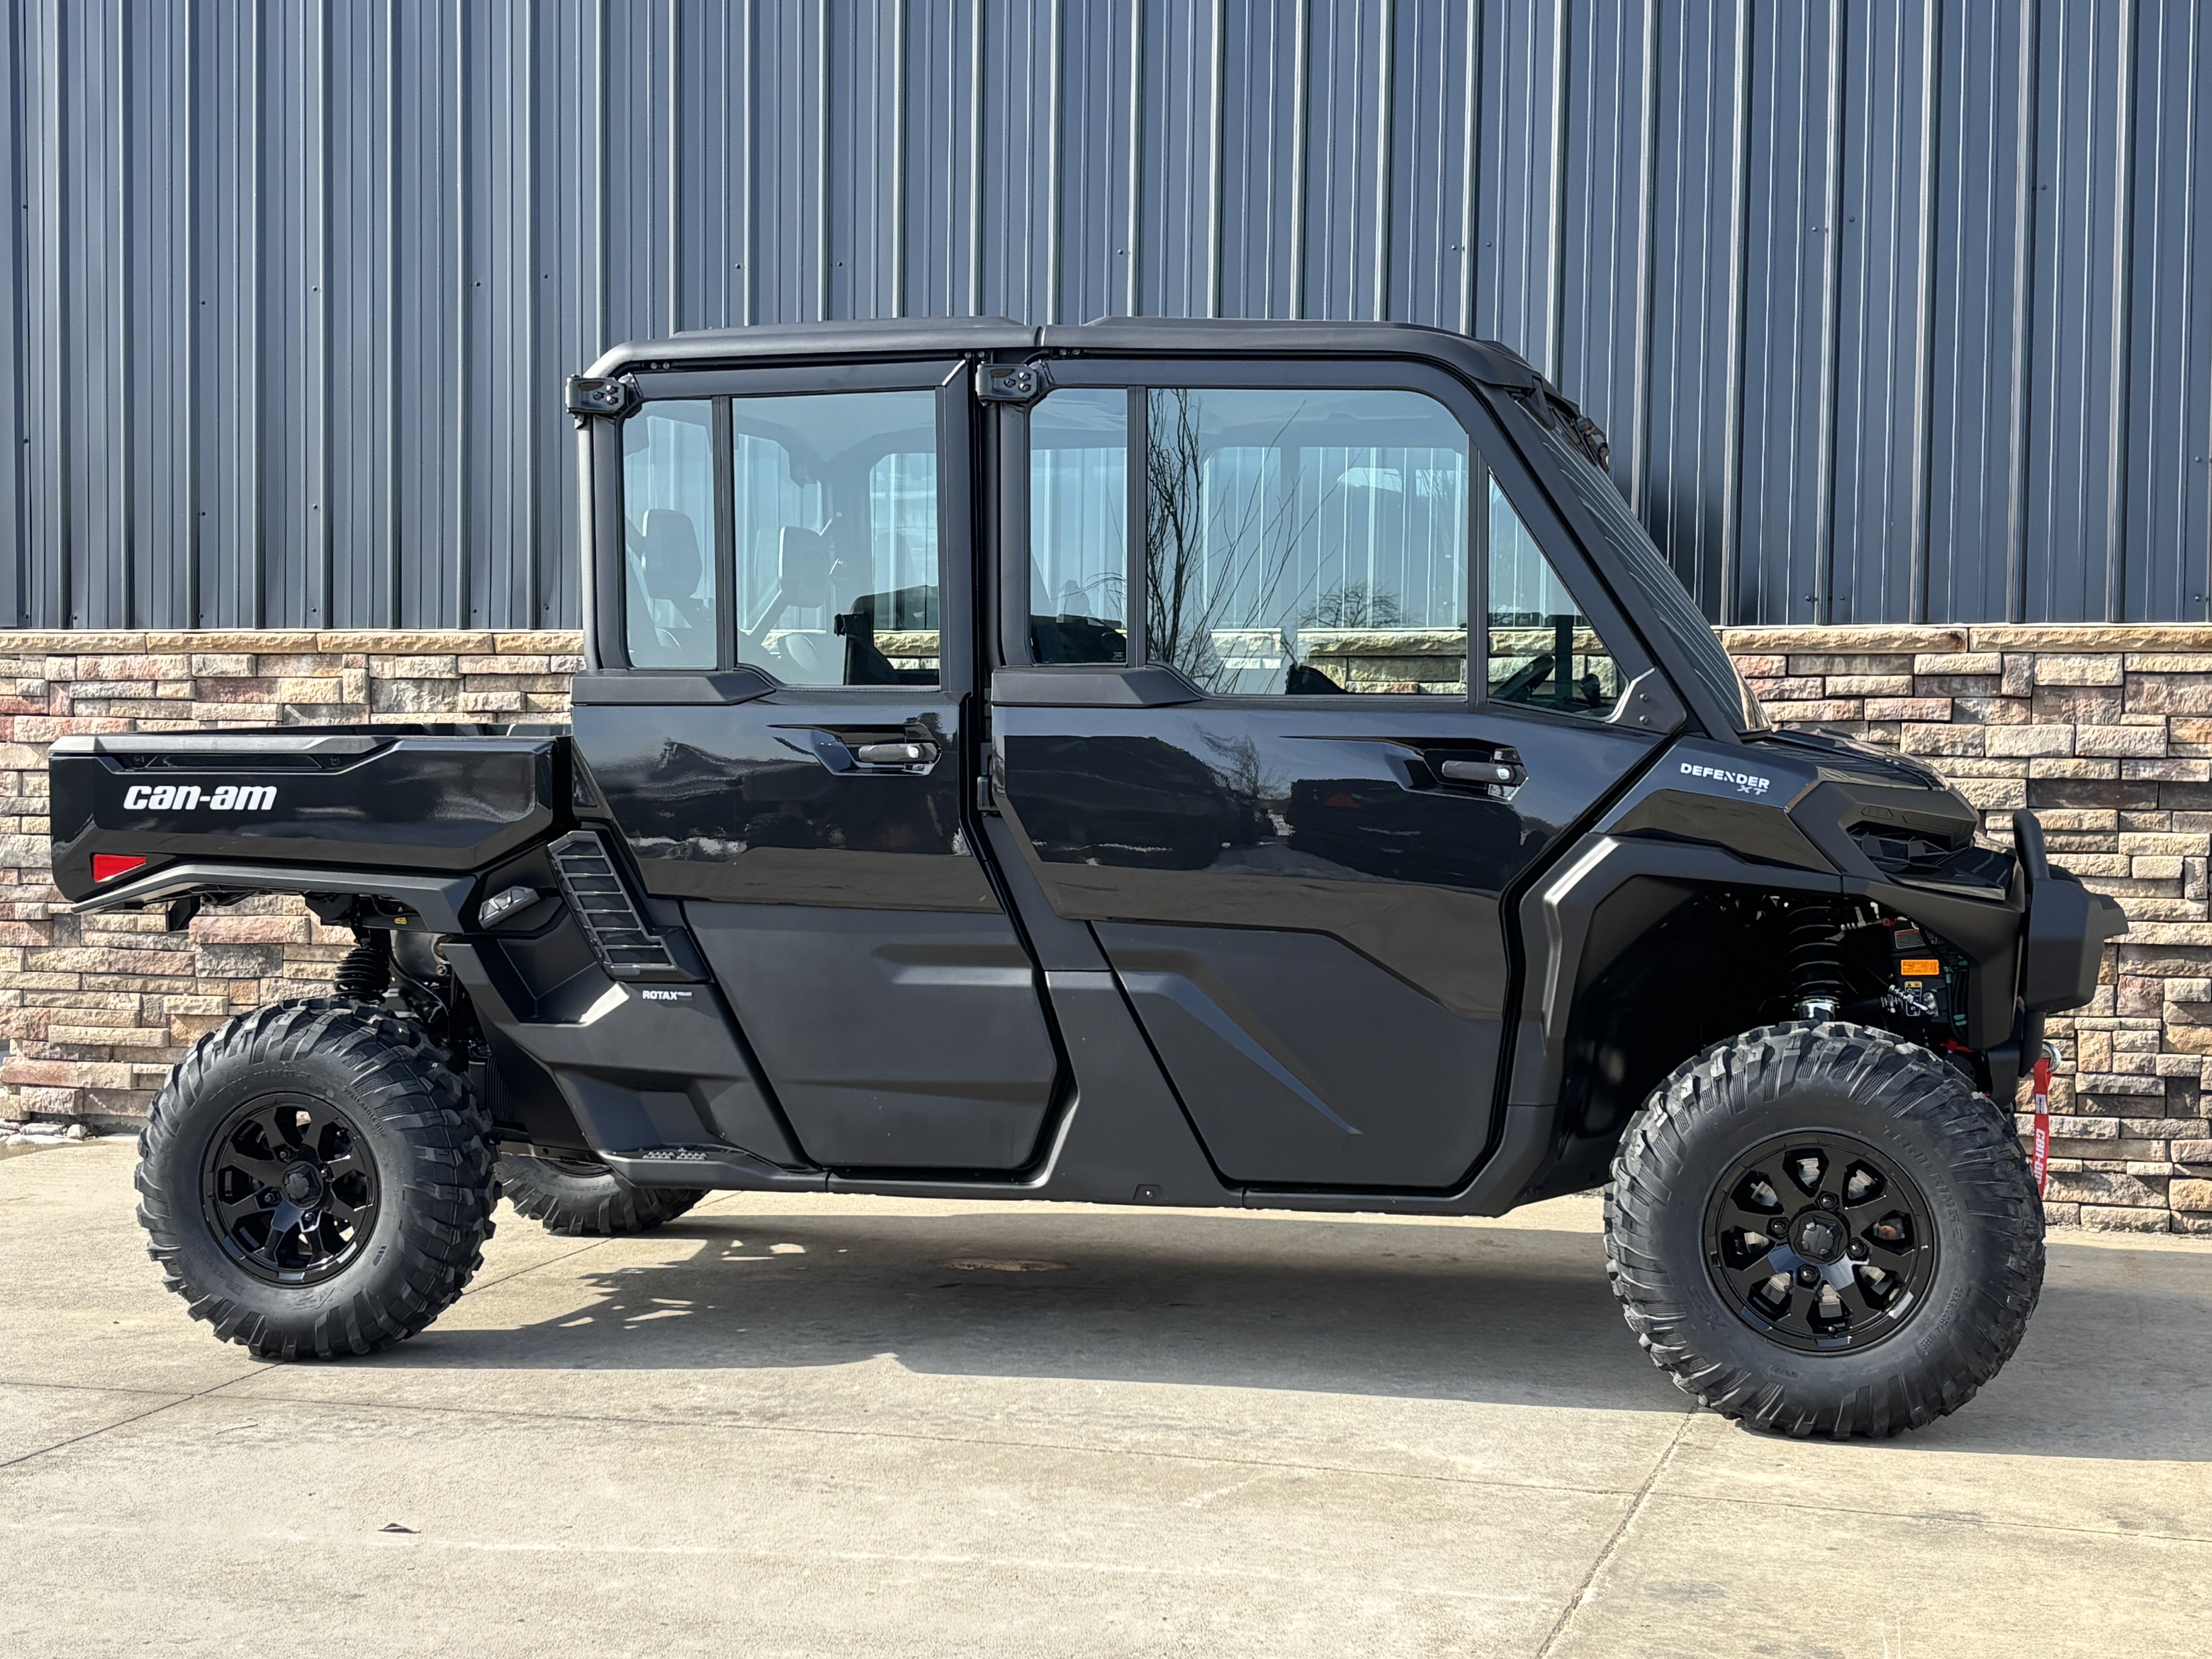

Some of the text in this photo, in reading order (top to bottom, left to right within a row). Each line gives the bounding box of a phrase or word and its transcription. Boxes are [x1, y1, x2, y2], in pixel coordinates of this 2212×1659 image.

[1680, 763, 1770, 789] DEFENDER
[124, 786, 276, 809] can-am
[1736, 785, 1767, 795] XT
[642, 990, 677, 1000] ROTAX
[2034, 1128, 2046, 1185] can-am
